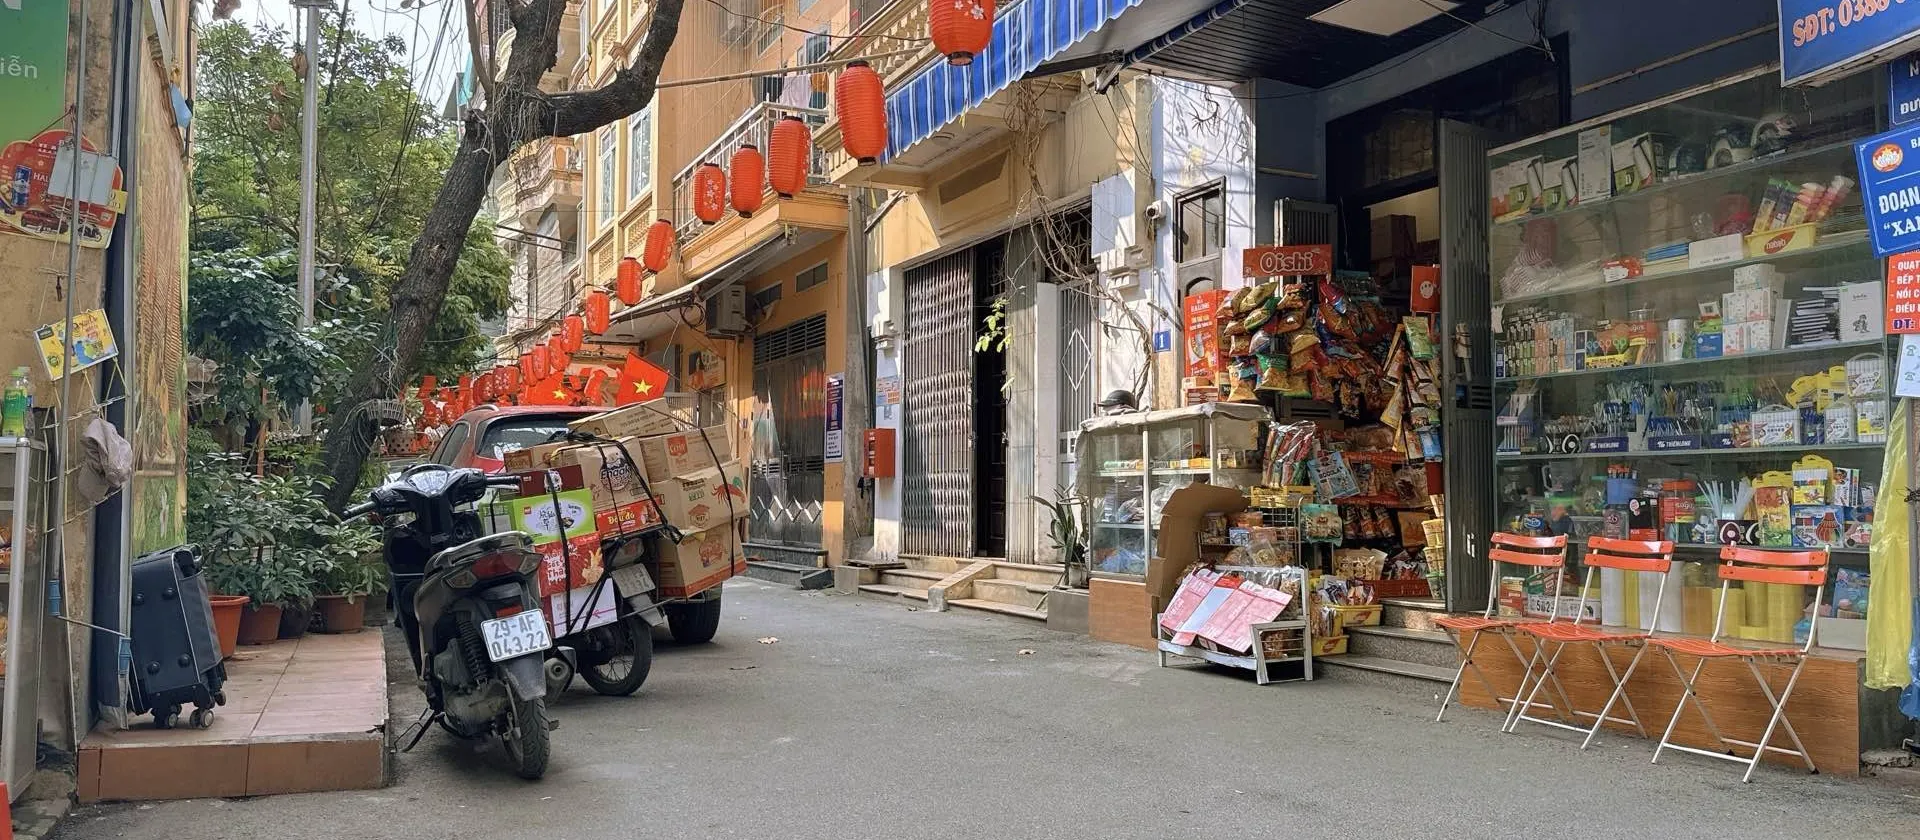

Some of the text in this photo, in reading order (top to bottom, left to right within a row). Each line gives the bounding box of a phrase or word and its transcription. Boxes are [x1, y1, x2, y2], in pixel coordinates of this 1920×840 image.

[1879, 186, 1920, 214] ĐOẠN
[1260, 251, 1313, 273] Oishi
[1159, 334, 1164, 348] 1
[491, 614, 536, 640] 29-AF
[491, 630, 547, 658] 043.22
